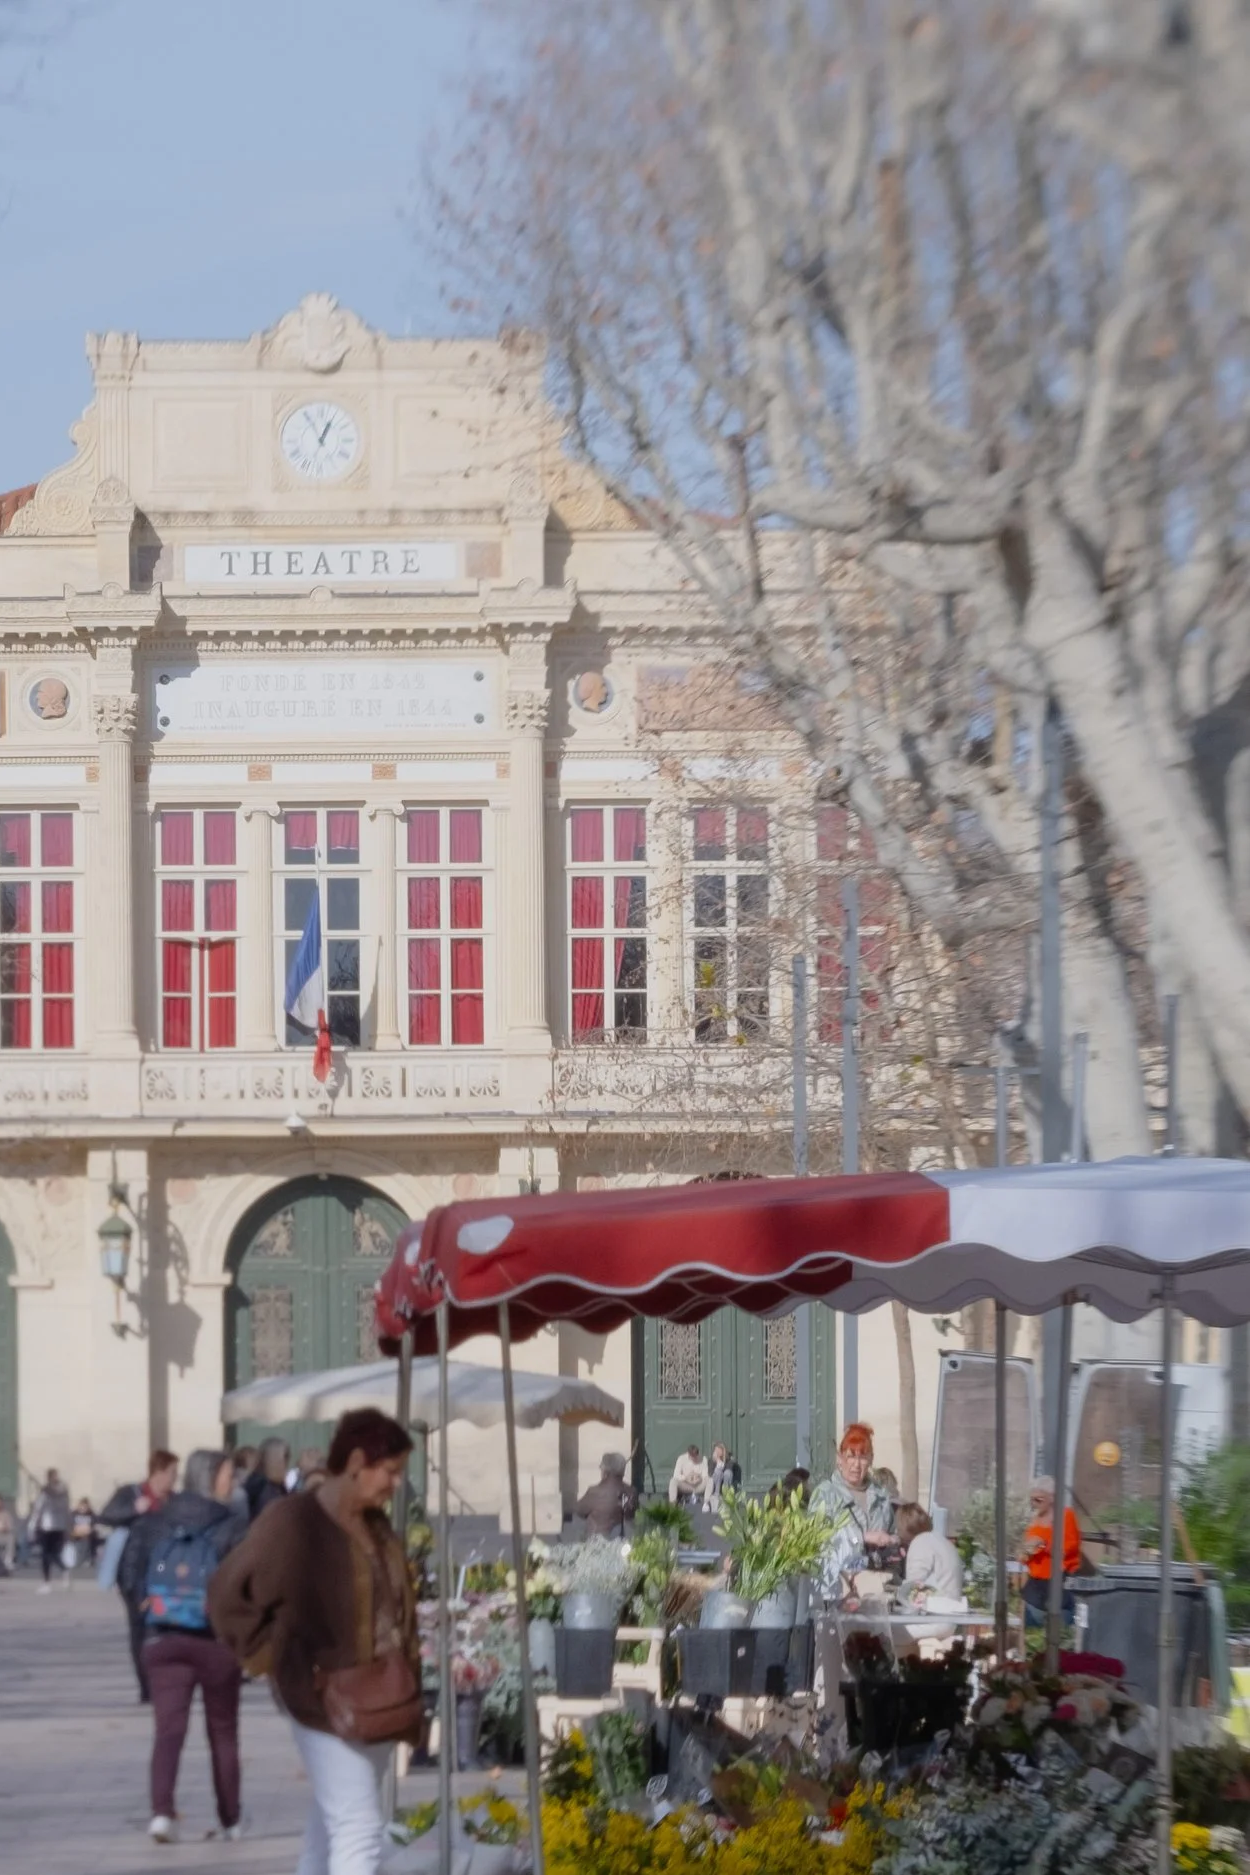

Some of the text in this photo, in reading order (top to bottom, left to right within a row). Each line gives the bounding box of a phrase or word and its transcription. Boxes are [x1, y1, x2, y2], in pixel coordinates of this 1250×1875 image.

[220, 550, 420, 575] THEATRE
[220, 668, 307, 692] FONDÉ
[322, 673, 357, 691] EN
[194, 694, 453, 718] INAUGURÉ EN 1844
